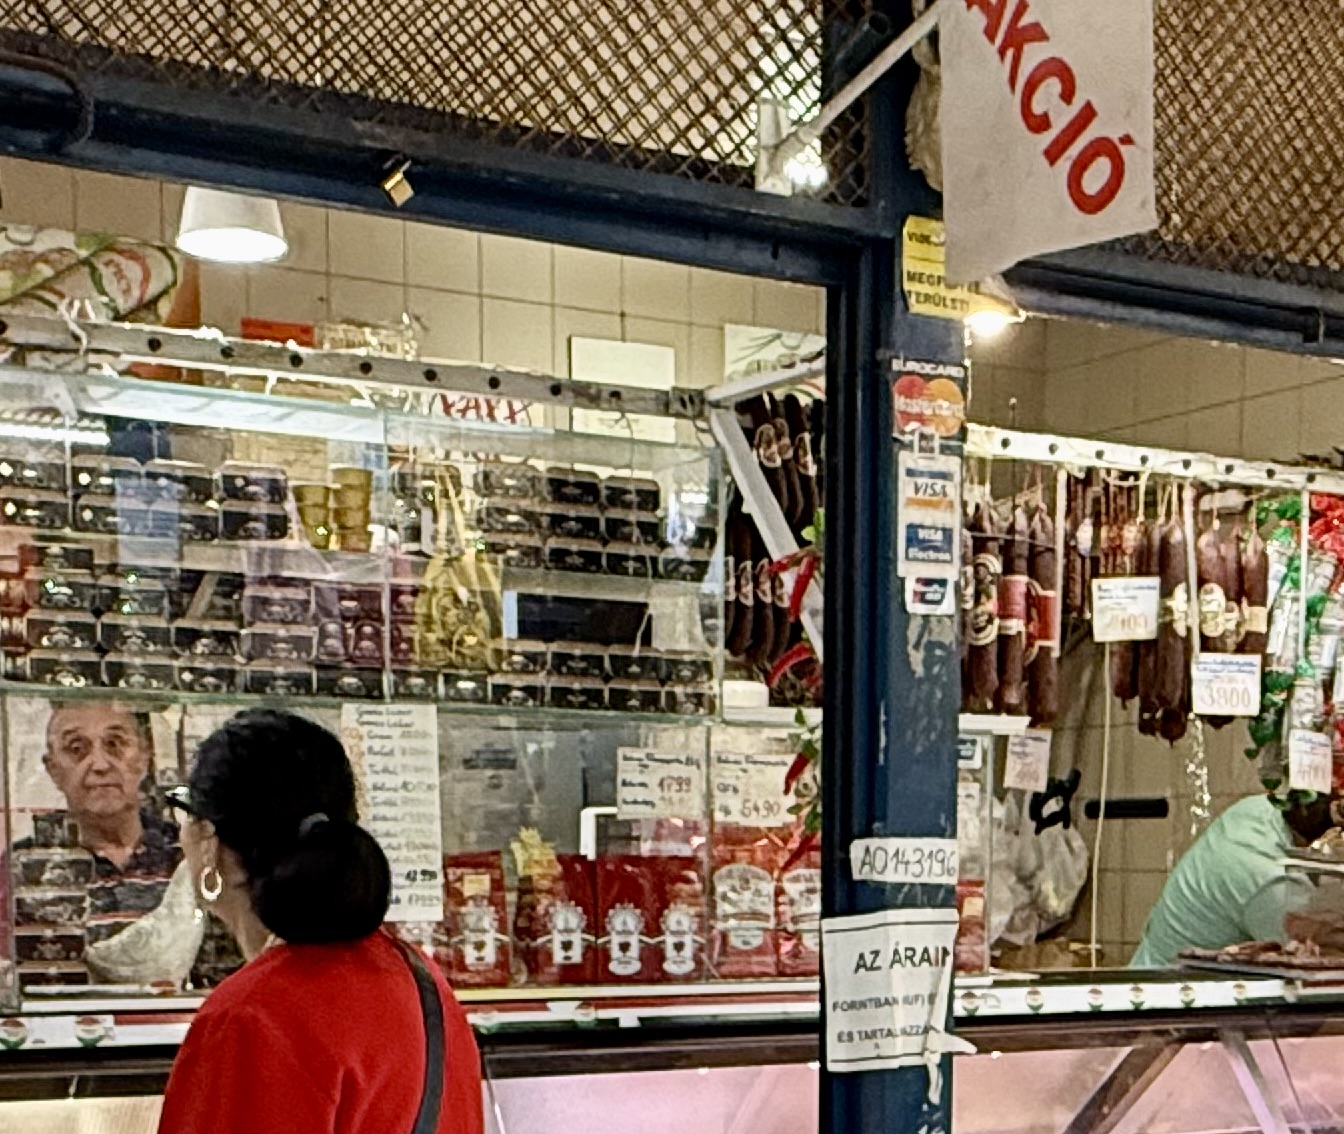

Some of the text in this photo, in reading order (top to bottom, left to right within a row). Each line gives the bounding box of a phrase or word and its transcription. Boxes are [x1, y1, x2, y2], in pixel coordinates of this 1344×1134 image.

[892, 359, 964, 377] EUROCARD
[914, 481, 948, 497] VISA
[918, 528, 943, 540] VISA
[854, 950, 882, 974] AZ
